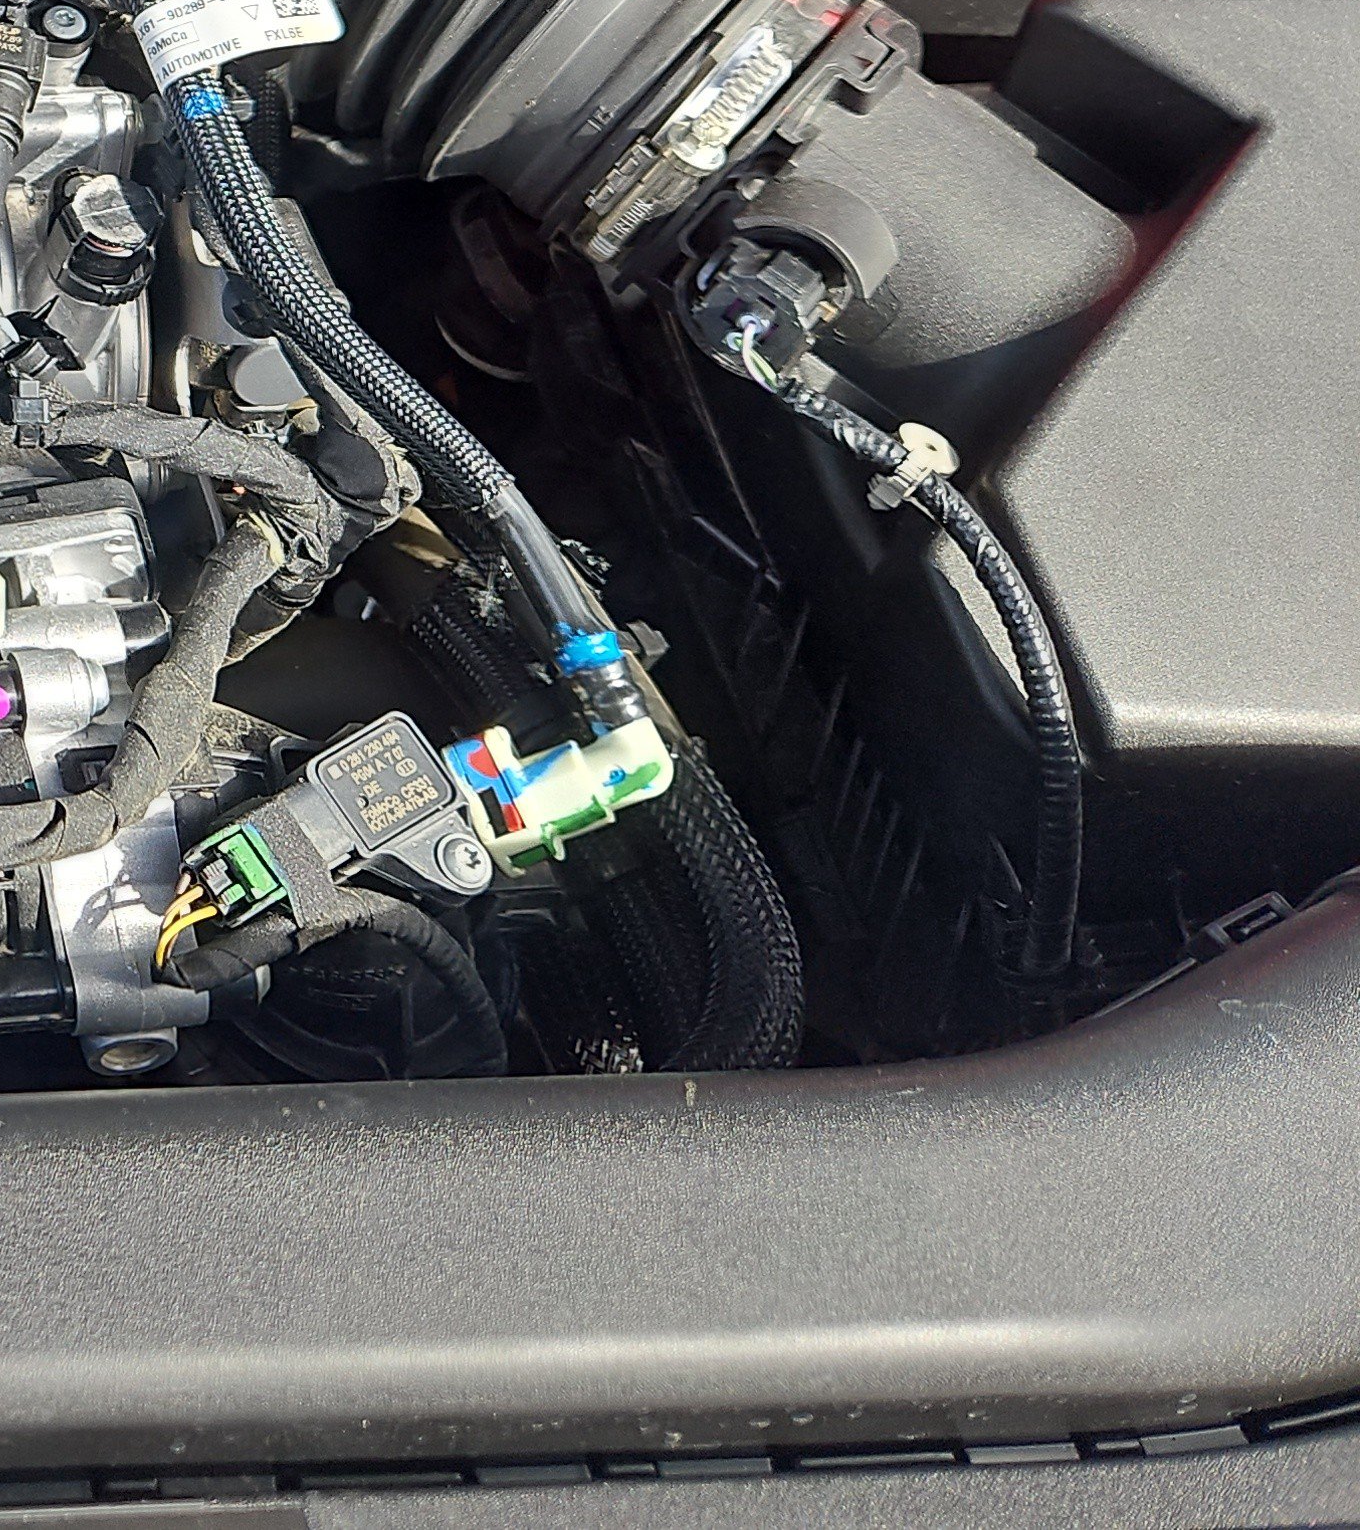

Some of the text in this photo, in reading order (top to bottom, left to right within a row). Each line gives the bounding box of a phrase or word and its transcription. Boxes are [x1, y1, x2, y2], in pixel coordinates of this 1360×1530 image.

[147, 30, 188, 59] FoMoCo
[161, 37, 242, 79] AUTOMOTIVE
[339, 759, 350, 772] 0
[362, 780, 383, 798] DE
[360, 794, 401, 822] FoMoCo
